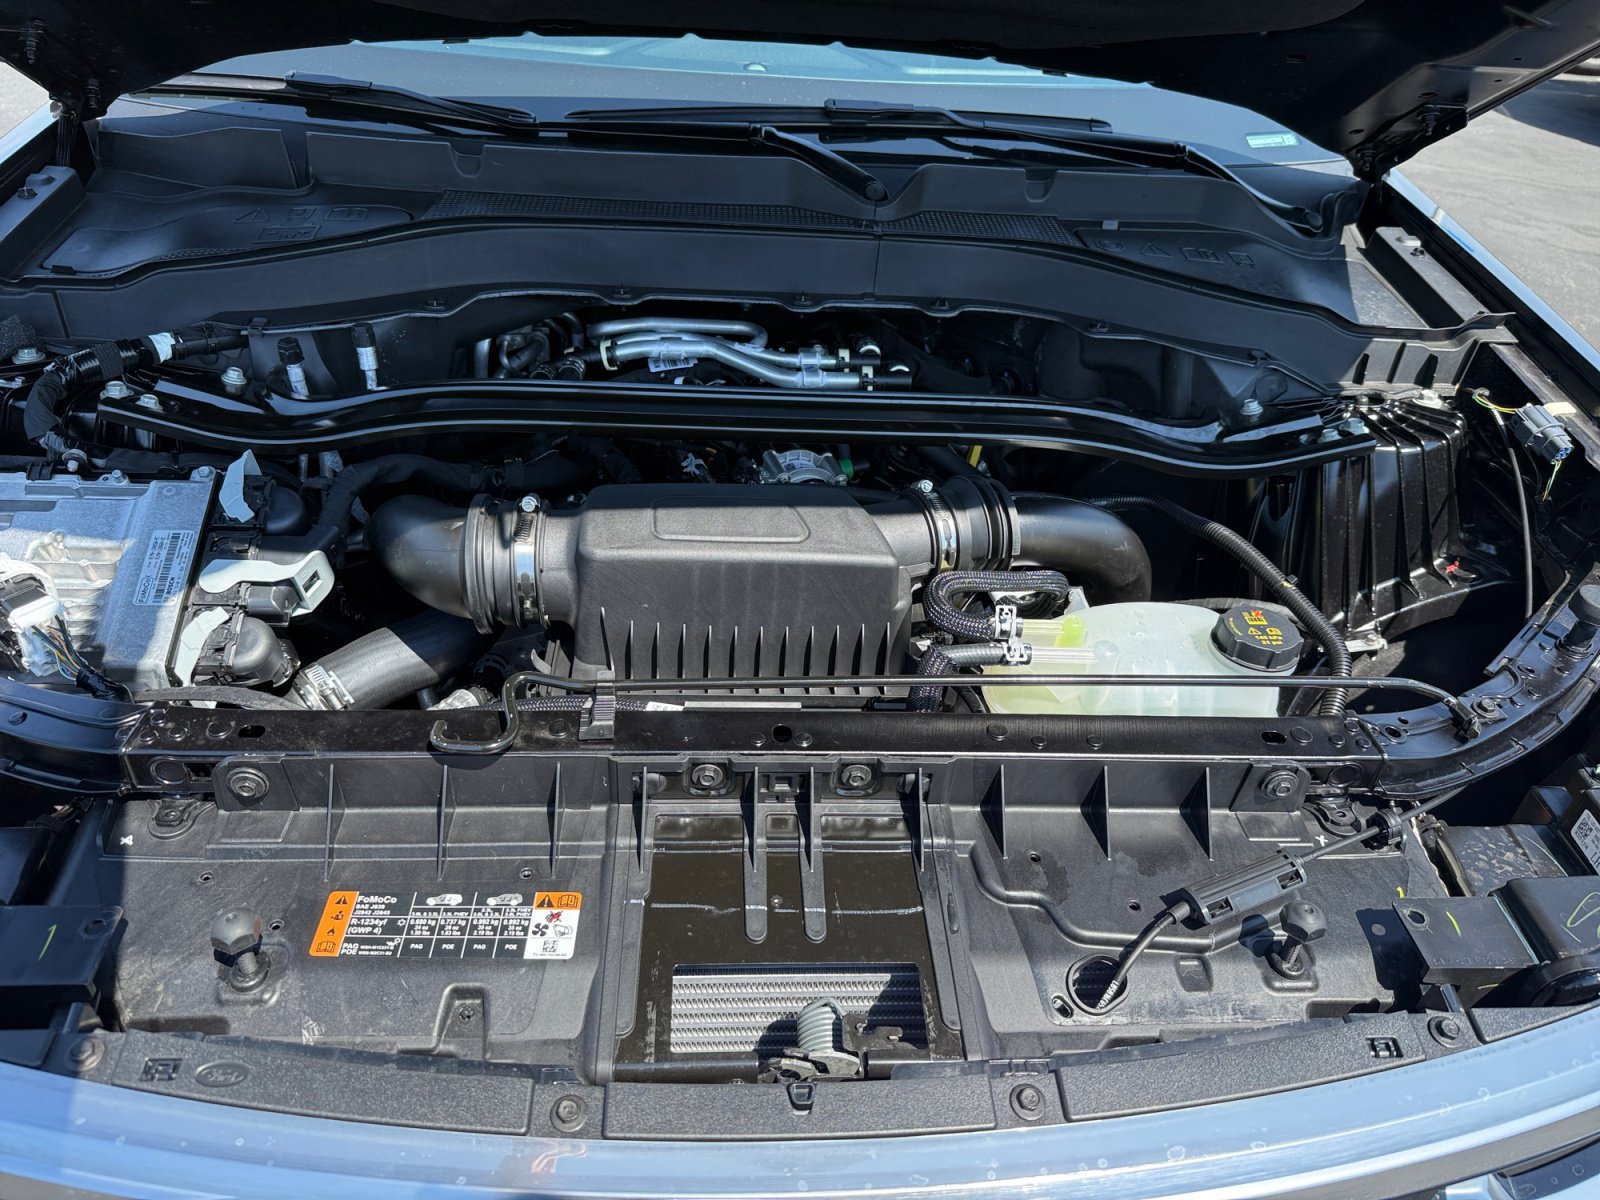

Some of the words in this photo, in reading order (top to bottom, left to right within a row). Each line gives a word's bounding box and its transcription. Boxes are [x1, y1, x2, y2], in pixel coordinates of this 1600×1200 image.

[138, 578, 151, 603] FoMoCo
[166, 576, 176, 595] BOSCH
[348, 927, 372, 935] (GWP
[373, 927, 382, 935] 4)
